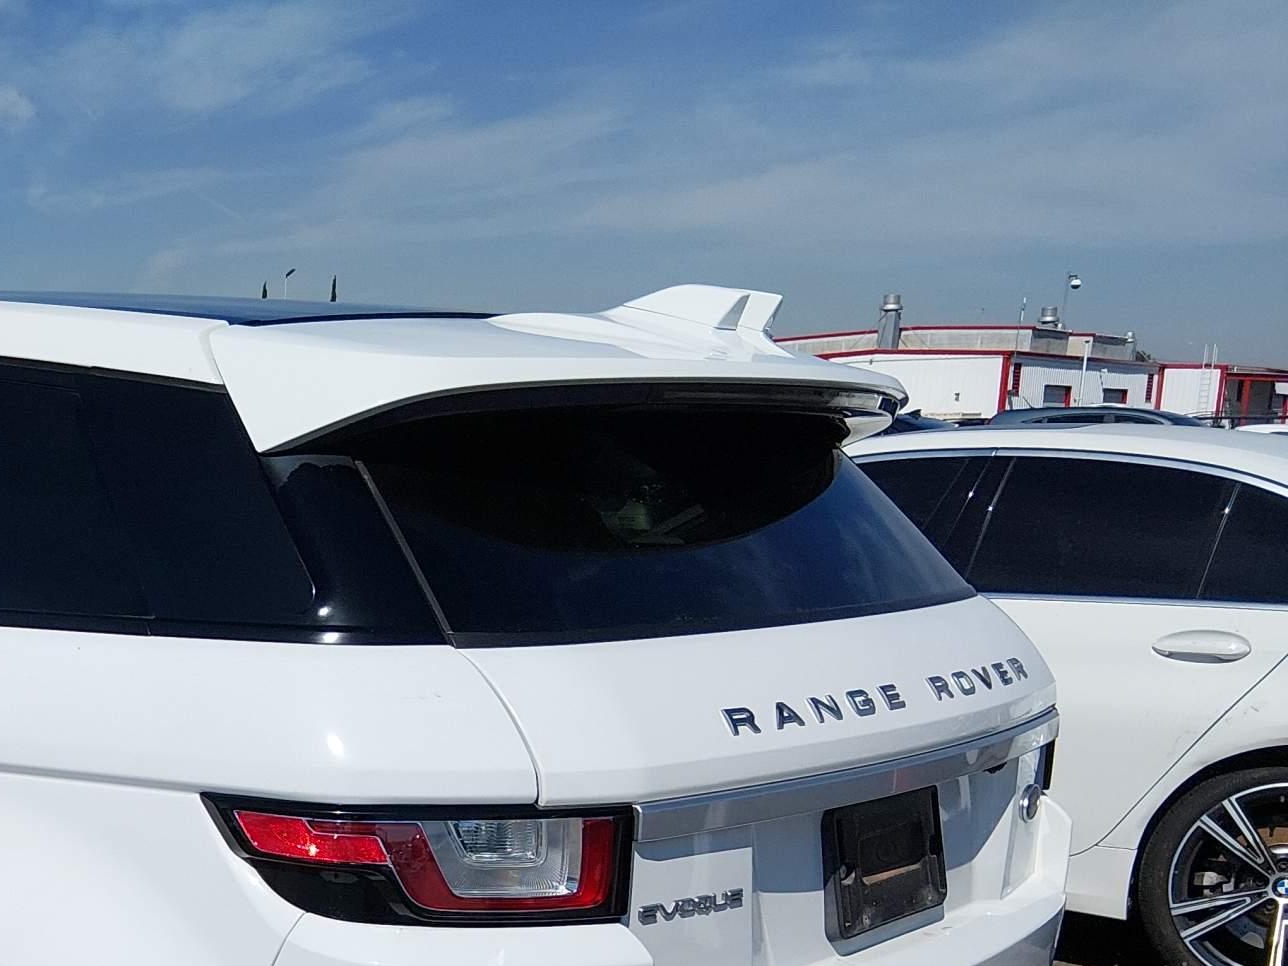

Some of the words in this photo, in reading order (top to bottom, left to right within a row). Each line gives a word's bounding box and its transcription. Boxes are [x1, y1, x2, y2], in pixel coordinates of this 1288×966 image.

[720, 683, 906, 736] RANGE
[924, 656, 1029, 702] ROVER
[637, 888, 744, 926] EVOQUE
